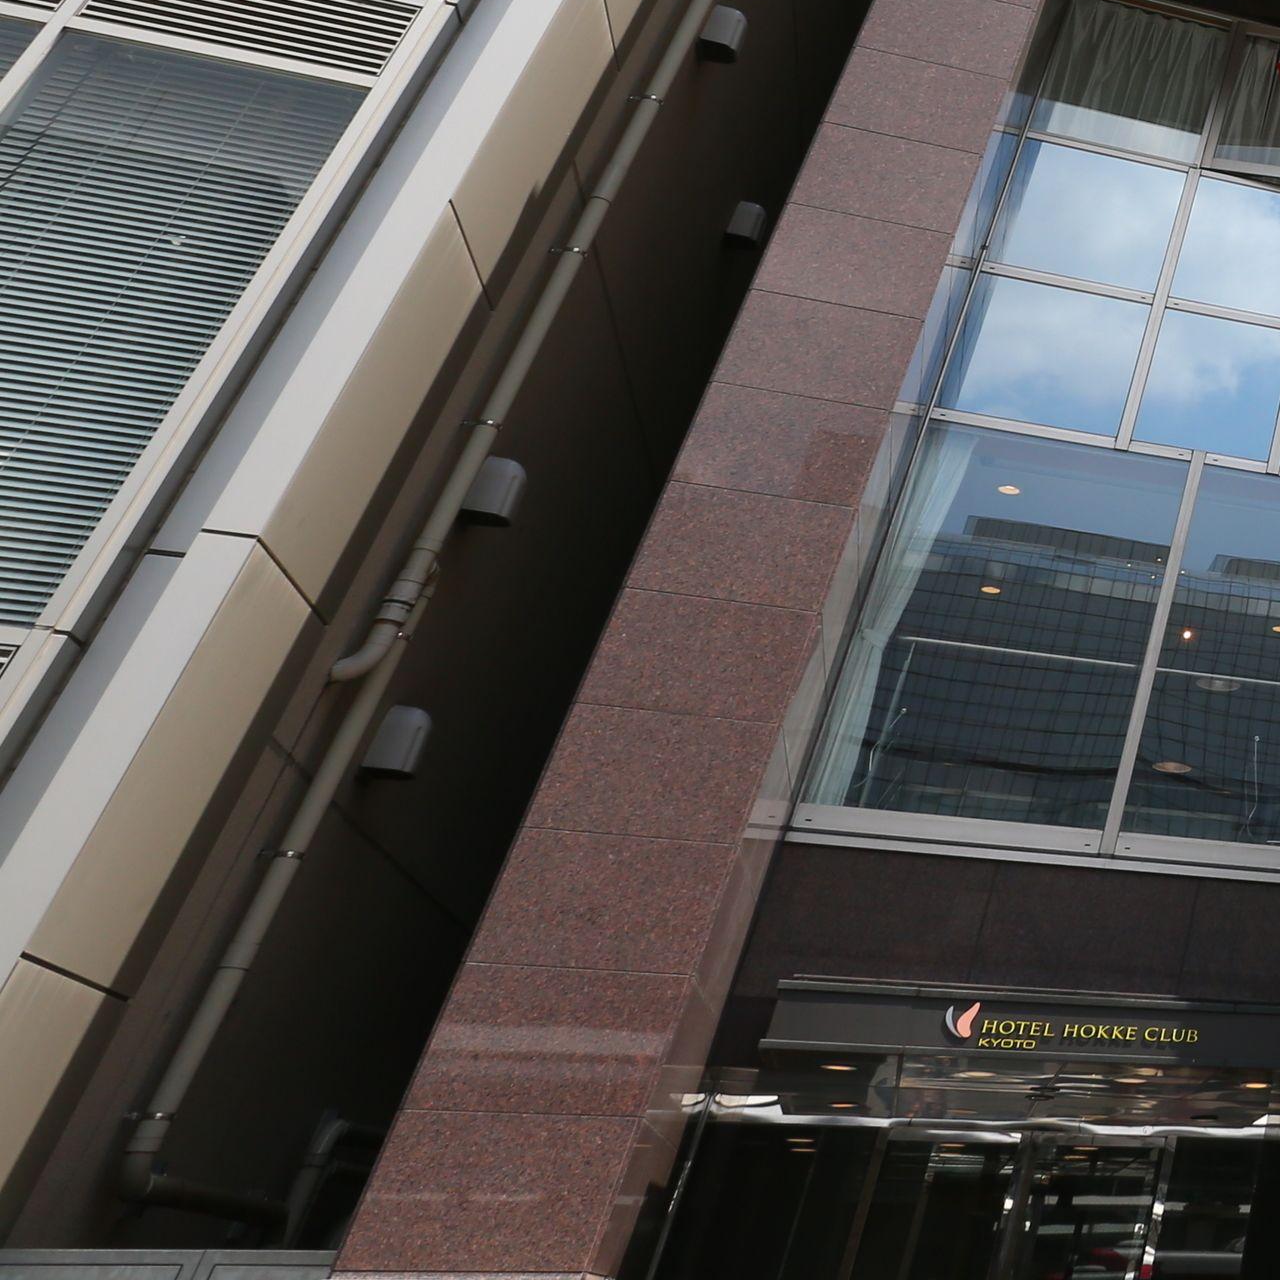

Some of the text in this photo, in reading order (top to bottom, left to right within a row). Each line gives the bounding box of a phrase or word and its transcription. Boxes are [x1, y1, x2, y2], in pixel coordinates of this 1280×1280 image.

[981, 1019, 1199, 1044] HOTEL HOKKE CLUB
[977, 1037, 1037, 1050] KYOTO
